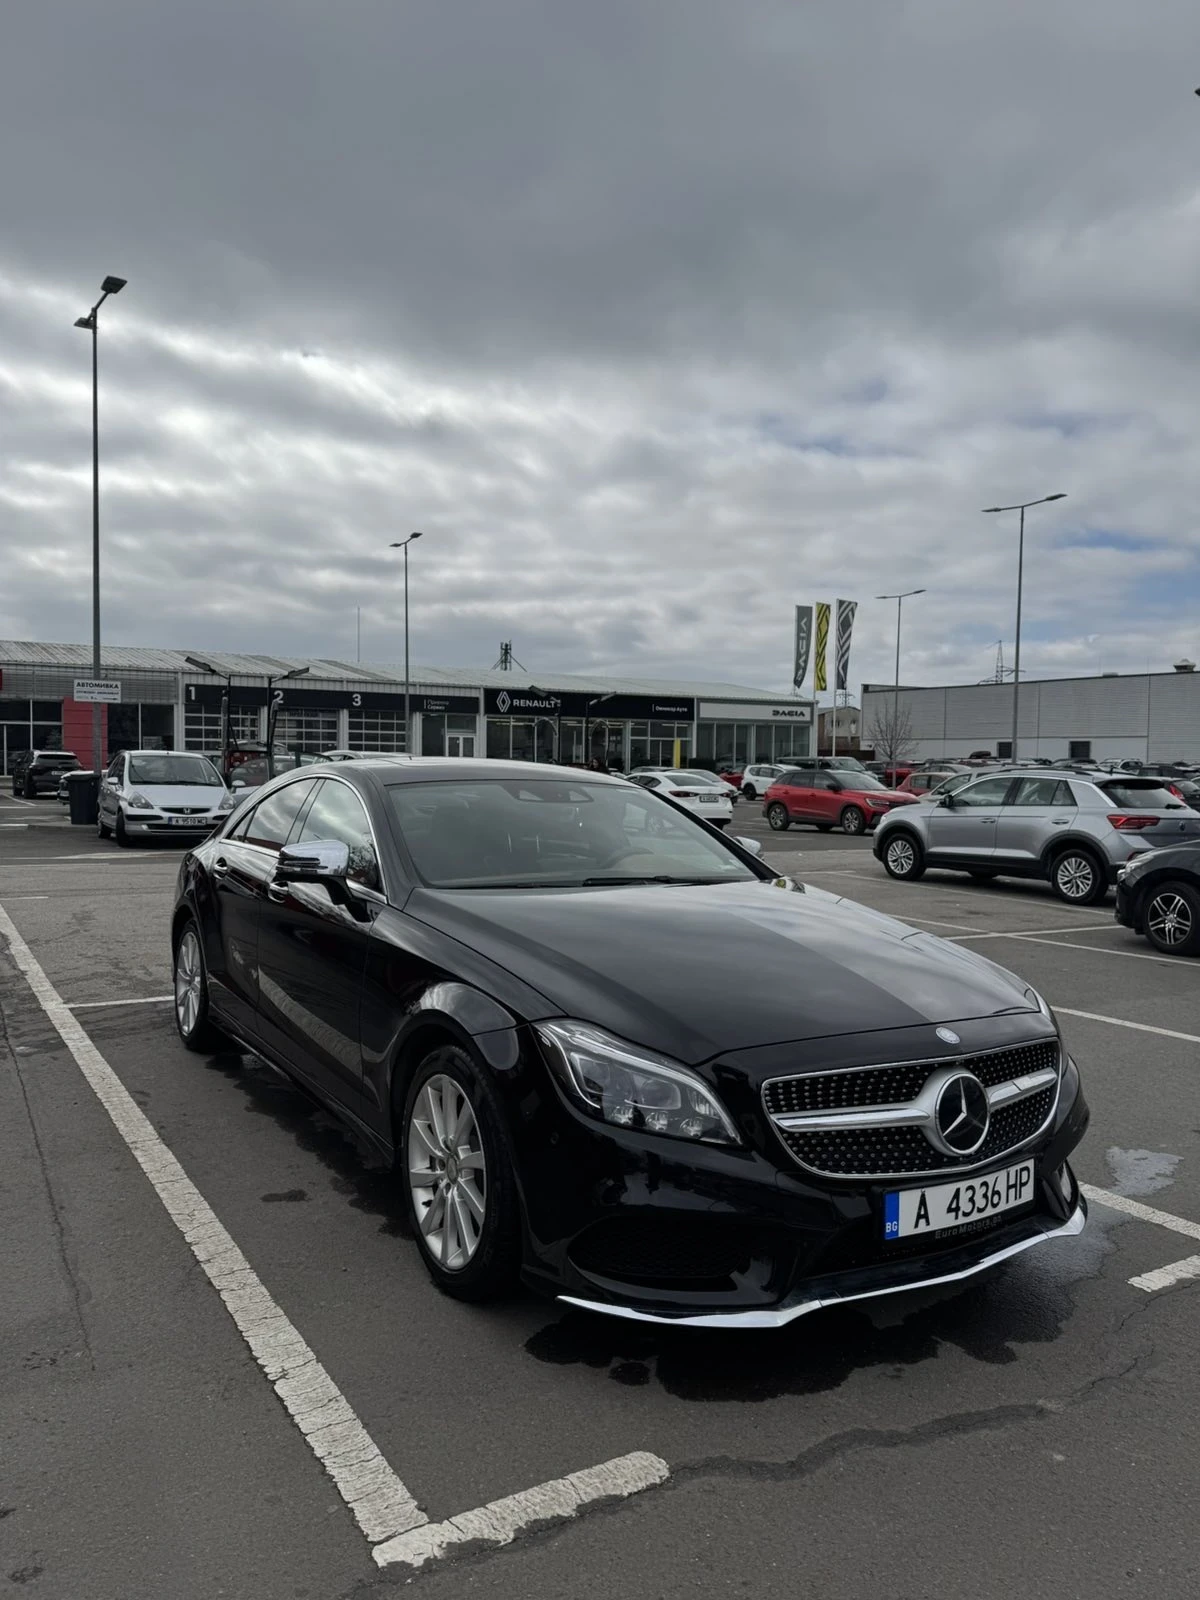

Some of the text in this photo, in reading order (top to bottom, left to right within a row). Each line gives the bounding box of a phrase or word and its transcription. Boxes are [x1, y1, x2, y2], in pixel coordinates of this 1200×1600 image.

[188, 686, 195, 701] 1
[273, 690, 284, 704] 2
[352, 694, 362, 707] 3
[512, 699, 555, 708] RENAULT
[914, 1166, 1031, 1229] A 4336 HP
[886, 1221, 898, 1233] BG
